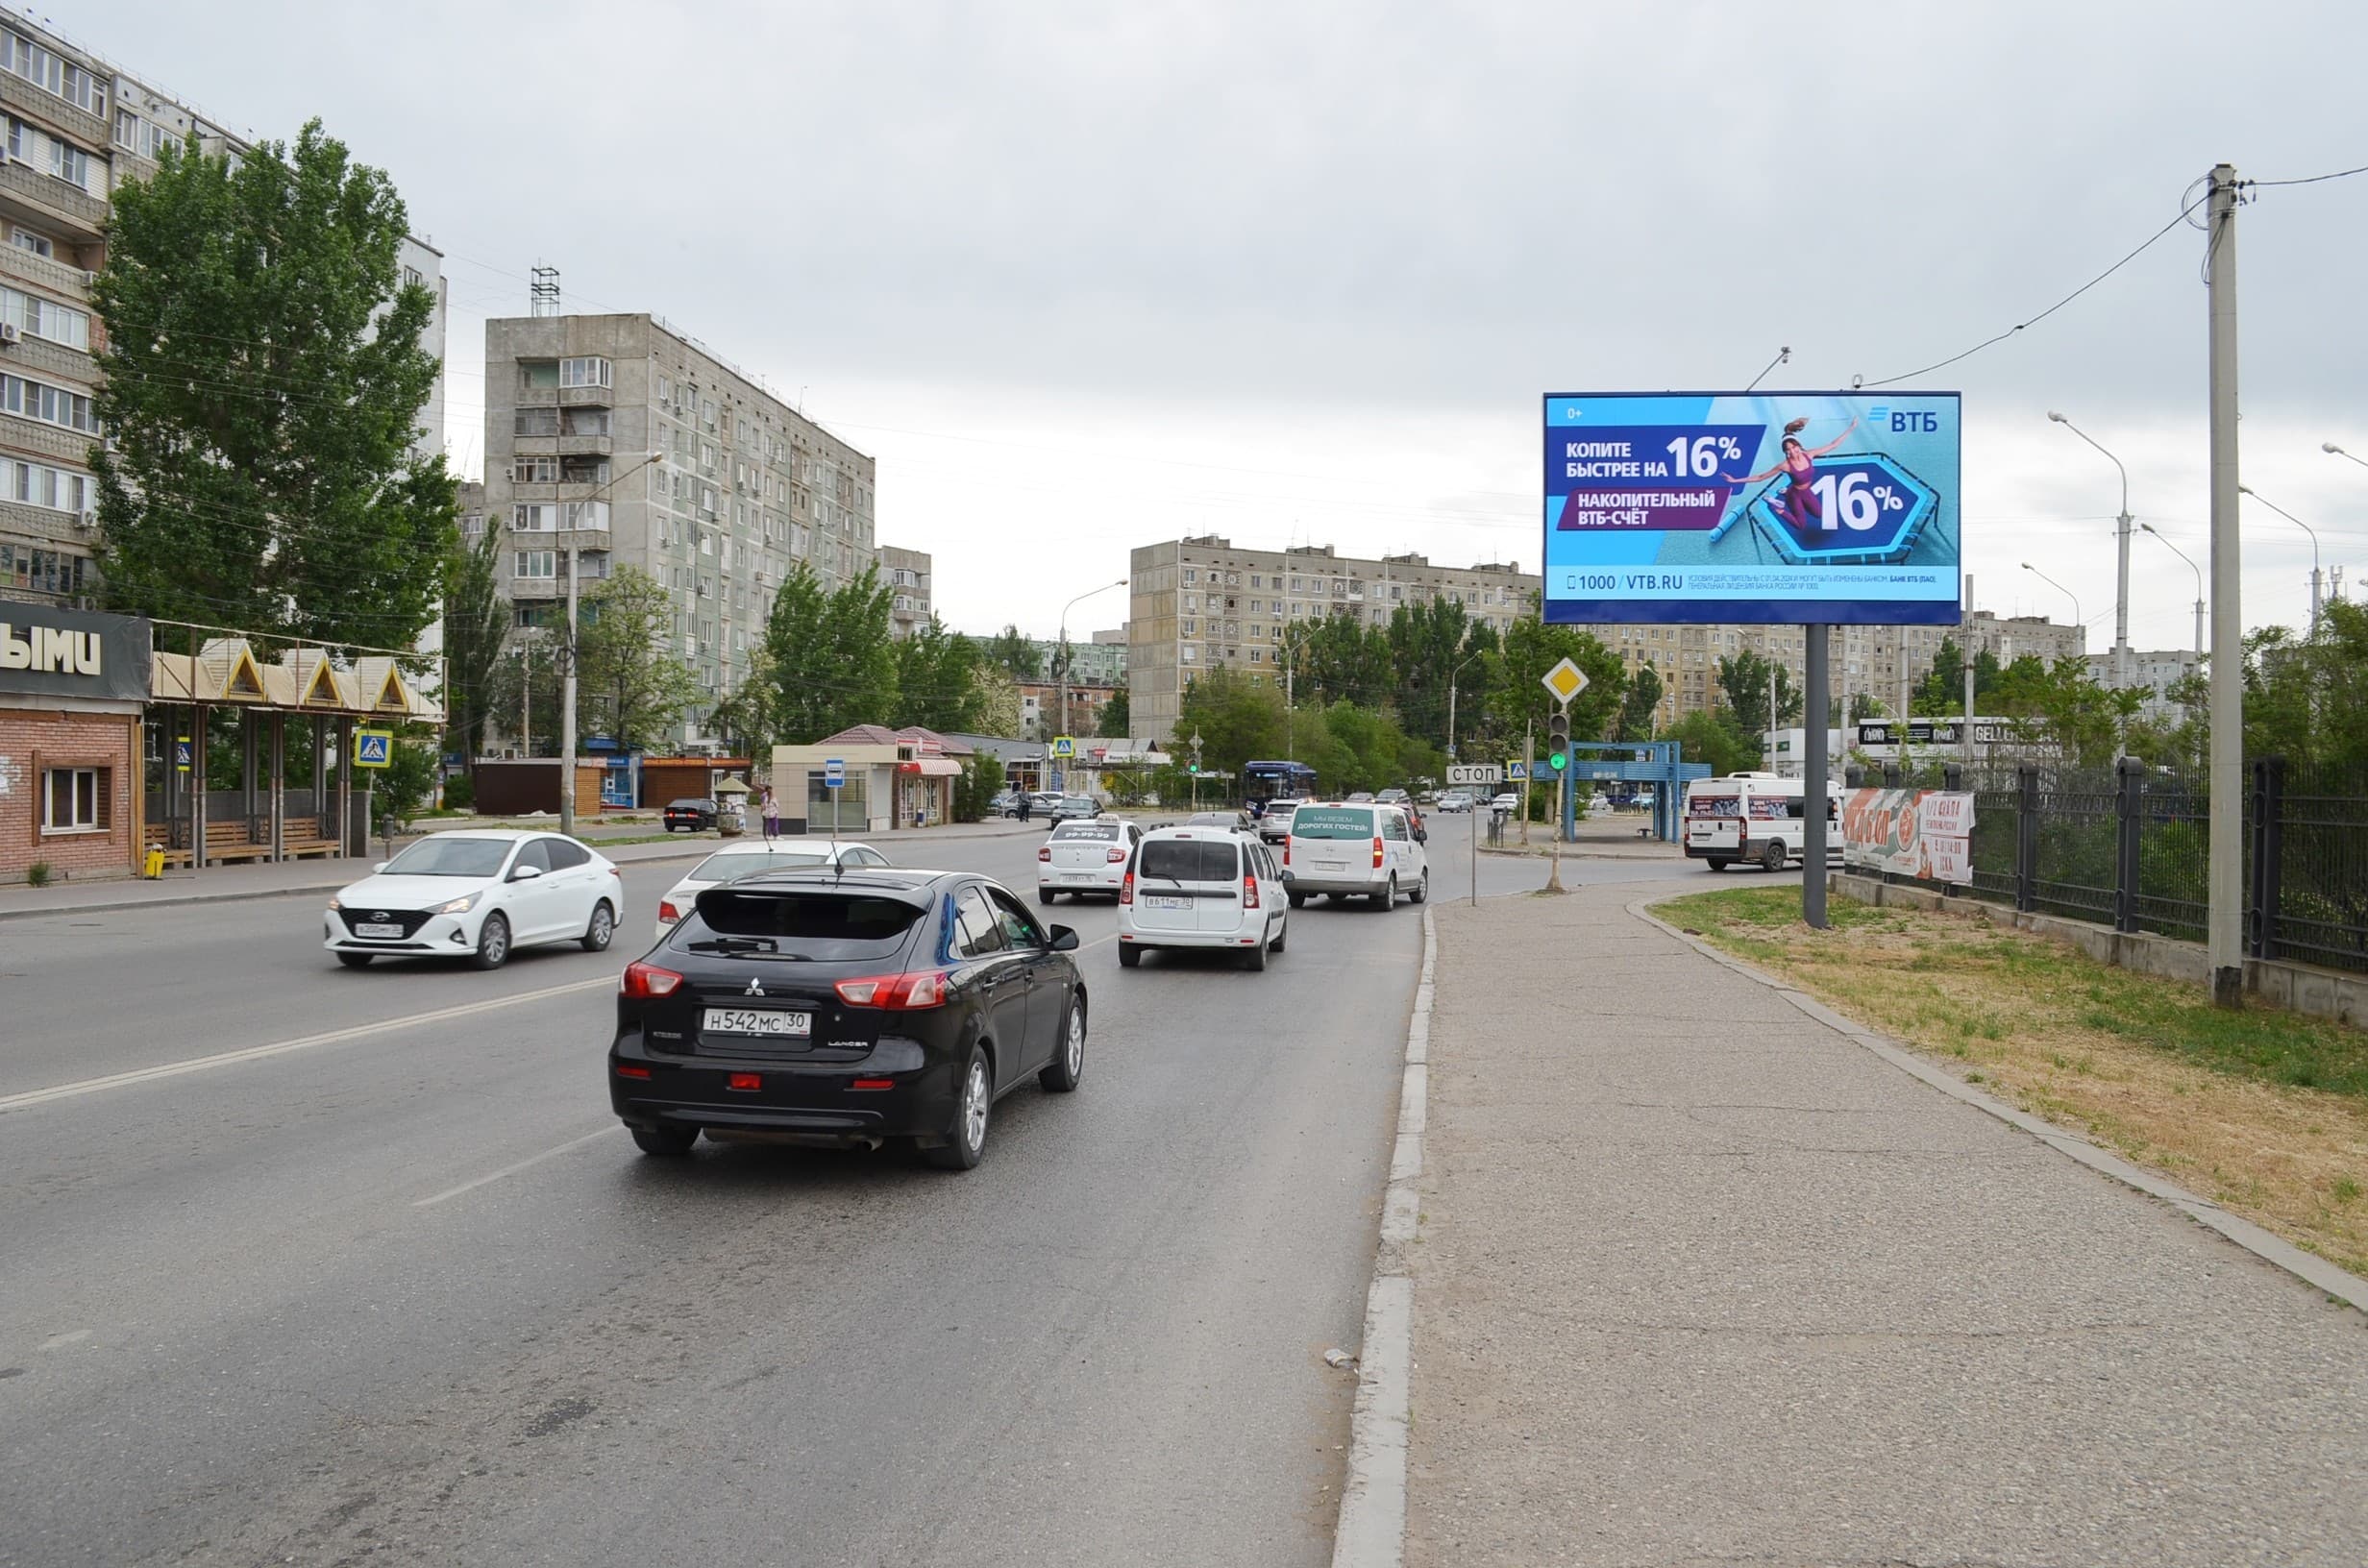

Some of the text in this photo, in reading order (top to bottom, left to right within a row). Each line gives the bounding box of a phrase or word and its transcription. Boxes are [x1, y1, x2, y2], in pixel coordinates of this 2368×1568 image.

[1567, 407, 1583, 419] 0+
[1891, 411, 1938, 432] ВТБ
[1566, 442, 1631, 458] КОПИТЕ
[1566, 436, 1742, 478] БЫСТРЕЕ НА 16%
[1577, 489, 1715, 508] НАКОПИТЕЛЬНЫЙ
[1810, 472, 1904, 530] 16%
[1577, 508, 1649, 526] ВТБ-СЧЁТ
[1579, 575, 1683, 590] 1000 VTB.RU
[1453, 768, 1495, 781] СТОП
[1335, 823, 1369, 832] ГОСТЕЙ!
[710, 1011, 803, 1032] Н542МС 30
